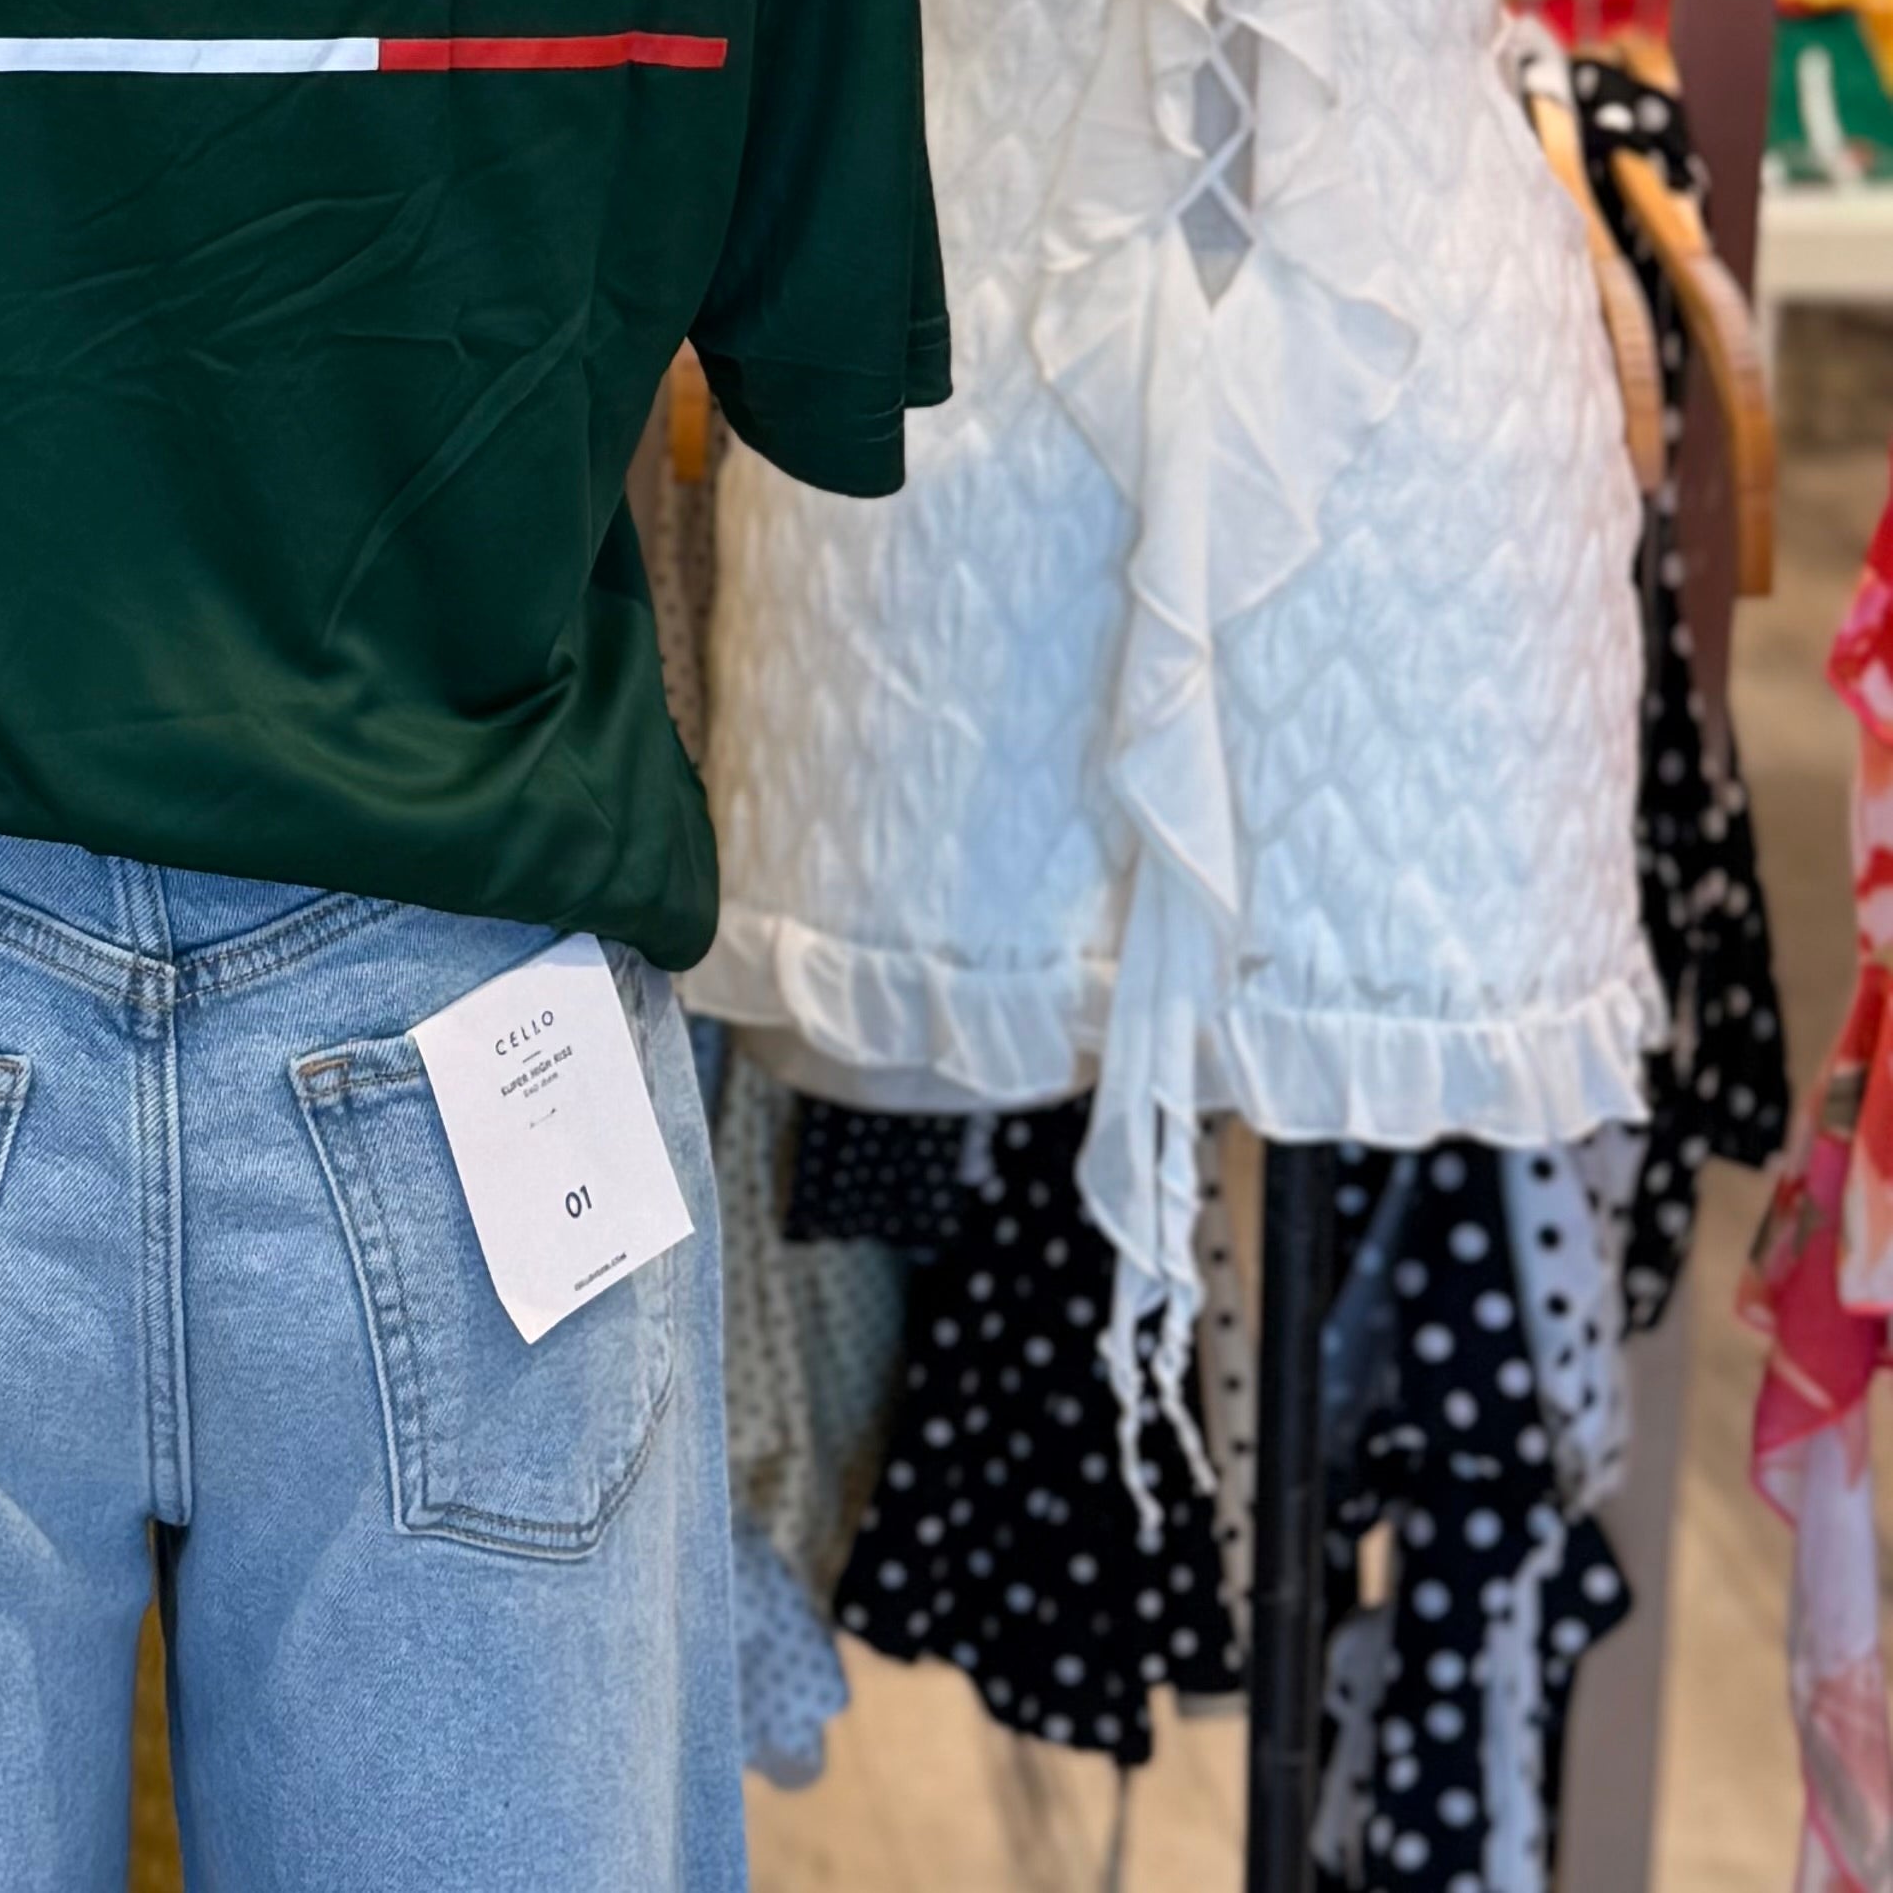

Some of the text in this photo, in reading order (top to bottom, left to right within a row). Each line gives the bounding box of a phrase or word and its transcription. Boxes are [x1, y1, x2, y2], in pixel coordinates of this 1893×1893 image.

[495, 1010, 554, 1056] CELLO
[500, 1072, 529, 1097] SUPER
[530, 1059, 553, 1079] HIGH
[564, 1184, 593, 1219] 01
